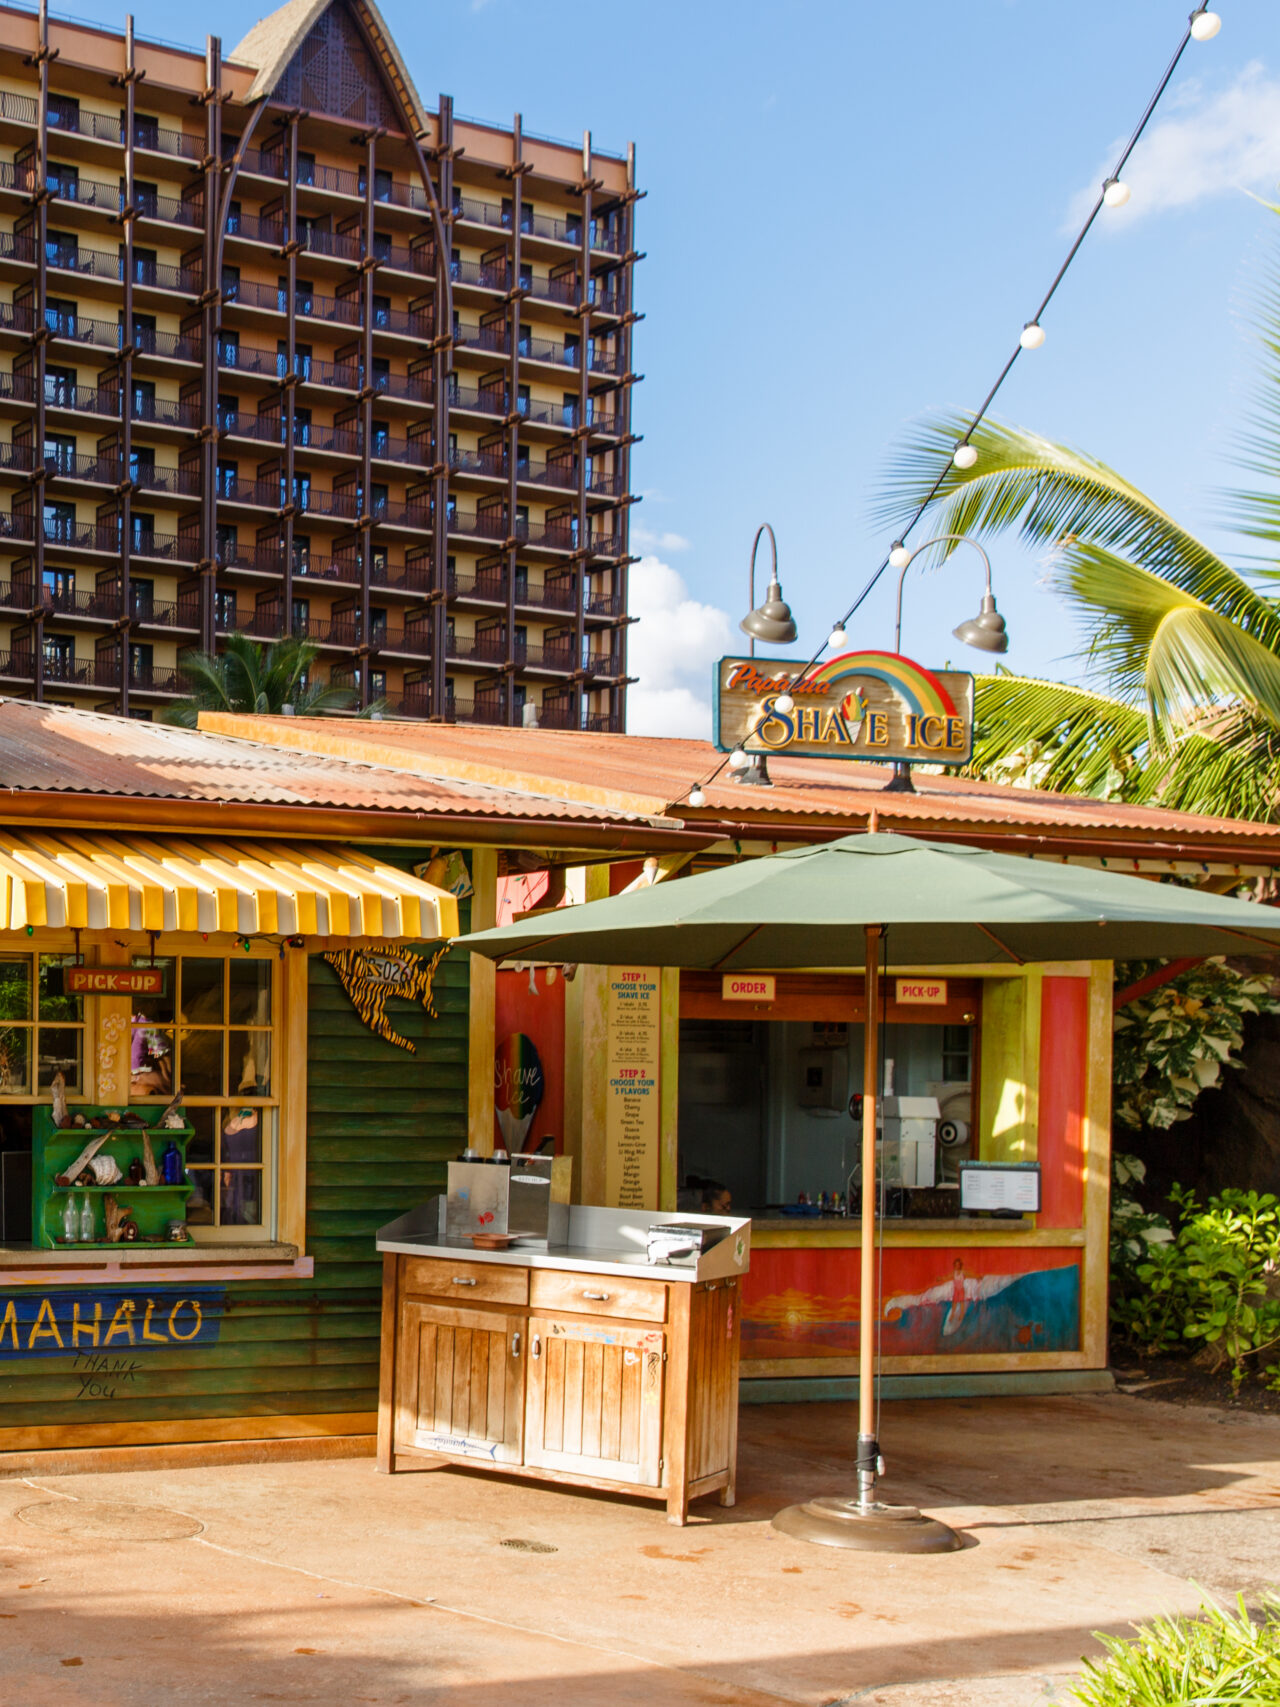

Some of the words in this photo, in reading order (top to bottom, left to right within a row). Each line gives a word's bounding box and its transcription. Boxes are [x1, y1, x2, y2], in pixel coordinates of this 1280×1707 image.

[904, 711, 965, 750] ICE
[73, 973, 156, 991] PICK-UP
[622, 972, 641, 982] STEP
[643, 973, 646, 982] 1
[612, 983, 636, 991] CHOOSE
[638, 983, 656, 991] YOUR
[731, 981, 767, 994] ORDER
[902, 986, 940, 998] PICK-UP
[494, 1059, 541, 1088] Shave
[619, 1069, 638, 1078] STEP
[641, 1070, 646, 1078] 2
[73, 1350, 143, 1382] THANK
